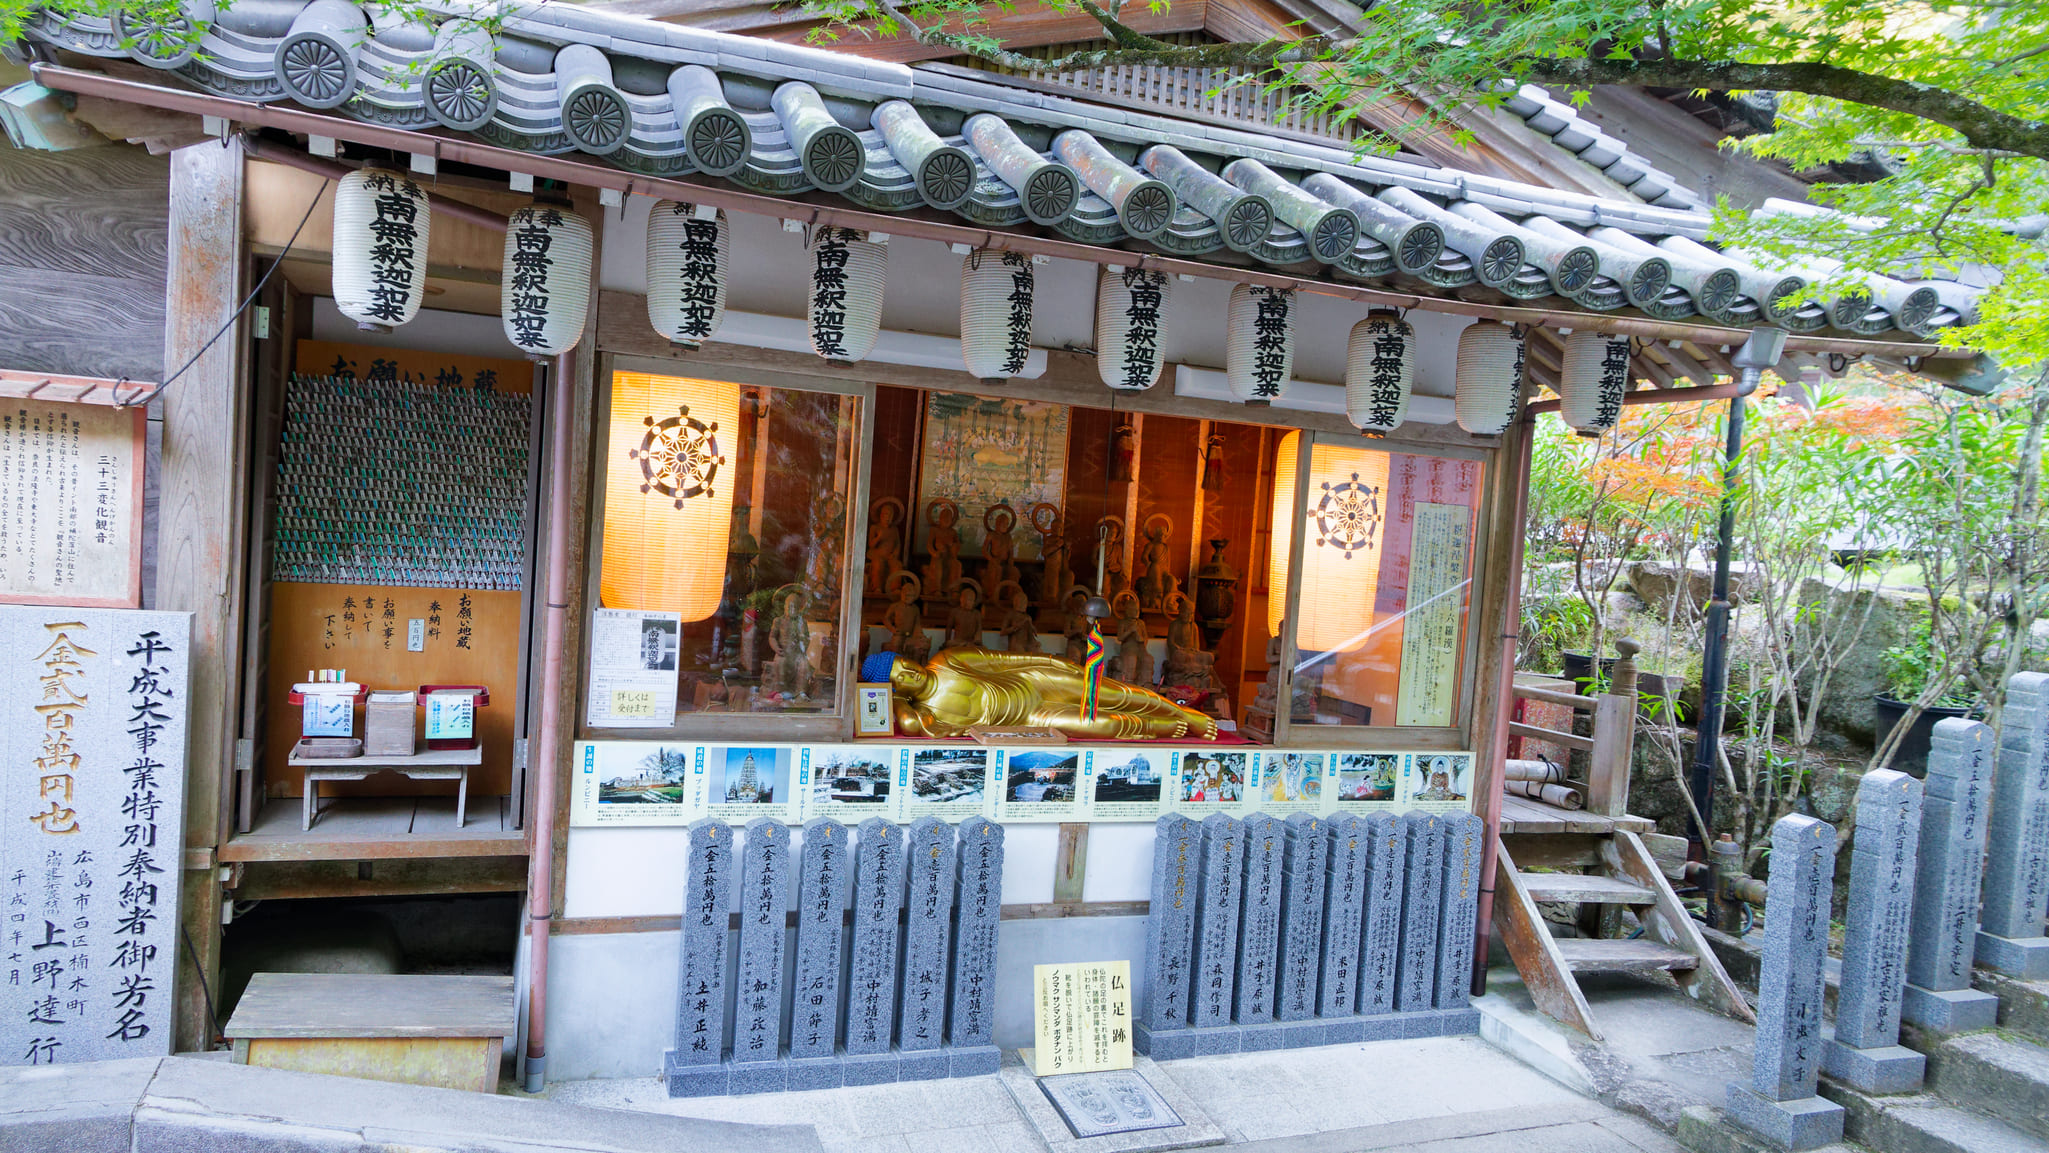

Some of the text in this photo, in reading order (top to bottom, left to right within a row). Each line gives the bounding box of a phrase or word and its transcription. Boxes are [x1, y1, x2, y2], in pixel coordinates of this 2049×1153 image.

[361, 193, 417, 323] 南無釈迦如来
[510, 224, 553, 349] 南無釈迦如来
[677, 218, 718, 337] 南無釈迦如来
[812, 241, 849, 356] 南無釈迦如来
[999, 269, 1034, 374] 南無釈迦如来
[1121, 281, 1161, 387] 南無釈迦如来
[1251, 295, 1288, 397] 南無釈迦如来
[1365, 333, 1405, 427] 南無釈迦如来
[1588, 341, 1630, 428] 南無釈迦如来
[95, 454, 110, 545] 三十三変化観音
[324, 614, 336, 649] 下さい
[343, 595, 357, 640] 奉納して
[363, 595, 376, 632] 書いて
[381, 597, 396, 649] お願い事を
[427, 600, 442, 640] 奉納料
[455, 593, 472, 650] お願い地蔵
[105, 630, 174, 1042] 平成大事業特別奉納者御芳名
[702, 845, 719, 926] 一金五拾萬円也
[758, 844, 776, 925] 一金五拾萬円也
[817, 843, 834, 923] 一金五拾萬円也
[872, 843, 889, 922] 一金五拾萬円也
[974, 841, 992, 918] 一金五拾萬円也
[8, 869, 27, 986] 平成四年七月
[24, 919, 68, 1065] 上野達行
[750, 978, 768, 1050] 加藤政治
[807, 975, 823, 1047] 石田節子
[1084, 969, 1092, 1013] いわれている
[1111, 975, 1126, 1043] 仏足跡
[1163, 956, 1181, 1020] 長野千秋
